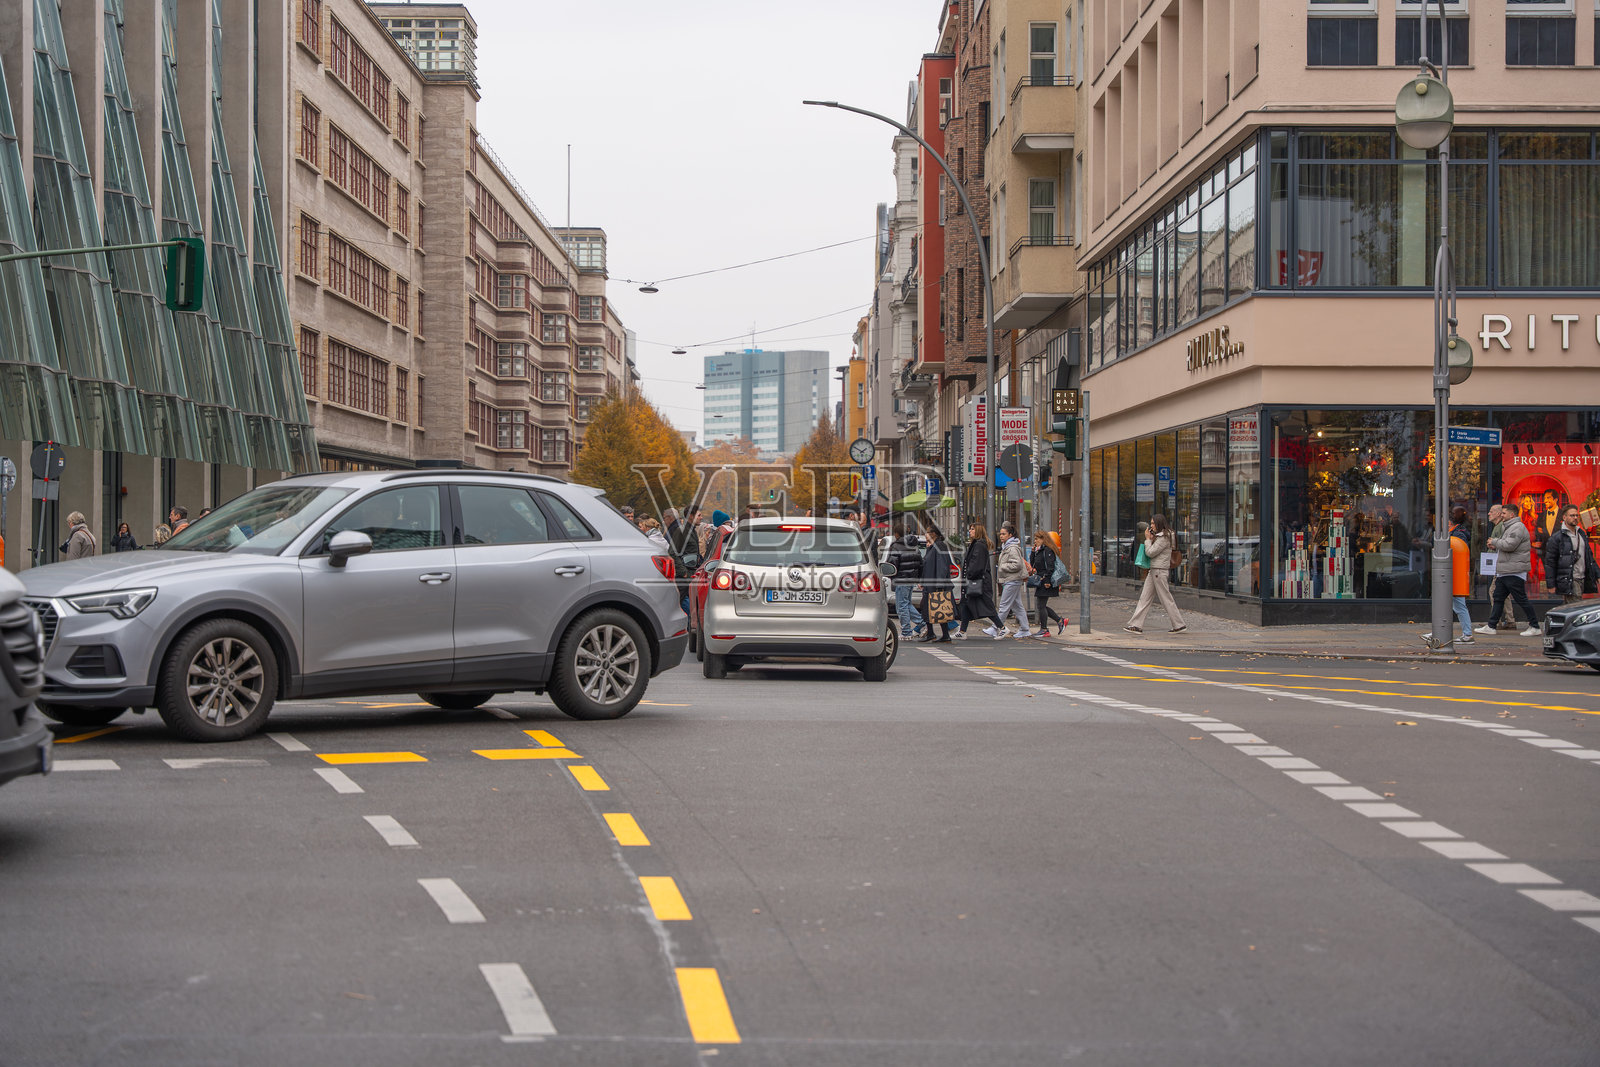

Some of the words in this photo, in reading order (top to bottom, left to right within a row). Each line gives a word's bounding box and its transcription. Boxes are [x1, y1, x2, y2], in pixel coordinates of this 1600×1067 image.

[1478, 314, 1600, 350] RIT
[1001, 420, 1028, 429] MODE
[973, 404, 987, 476] Weingarten
[1513, 456, 1556, 465] FROHE
[1560, 456, 1600, 465] FESTT
[927, 481, 935, 493] P
[772, 591, 779, 600] B
[785, 592, 797, 600] JM
[798, 591, 822, 601] 3535
